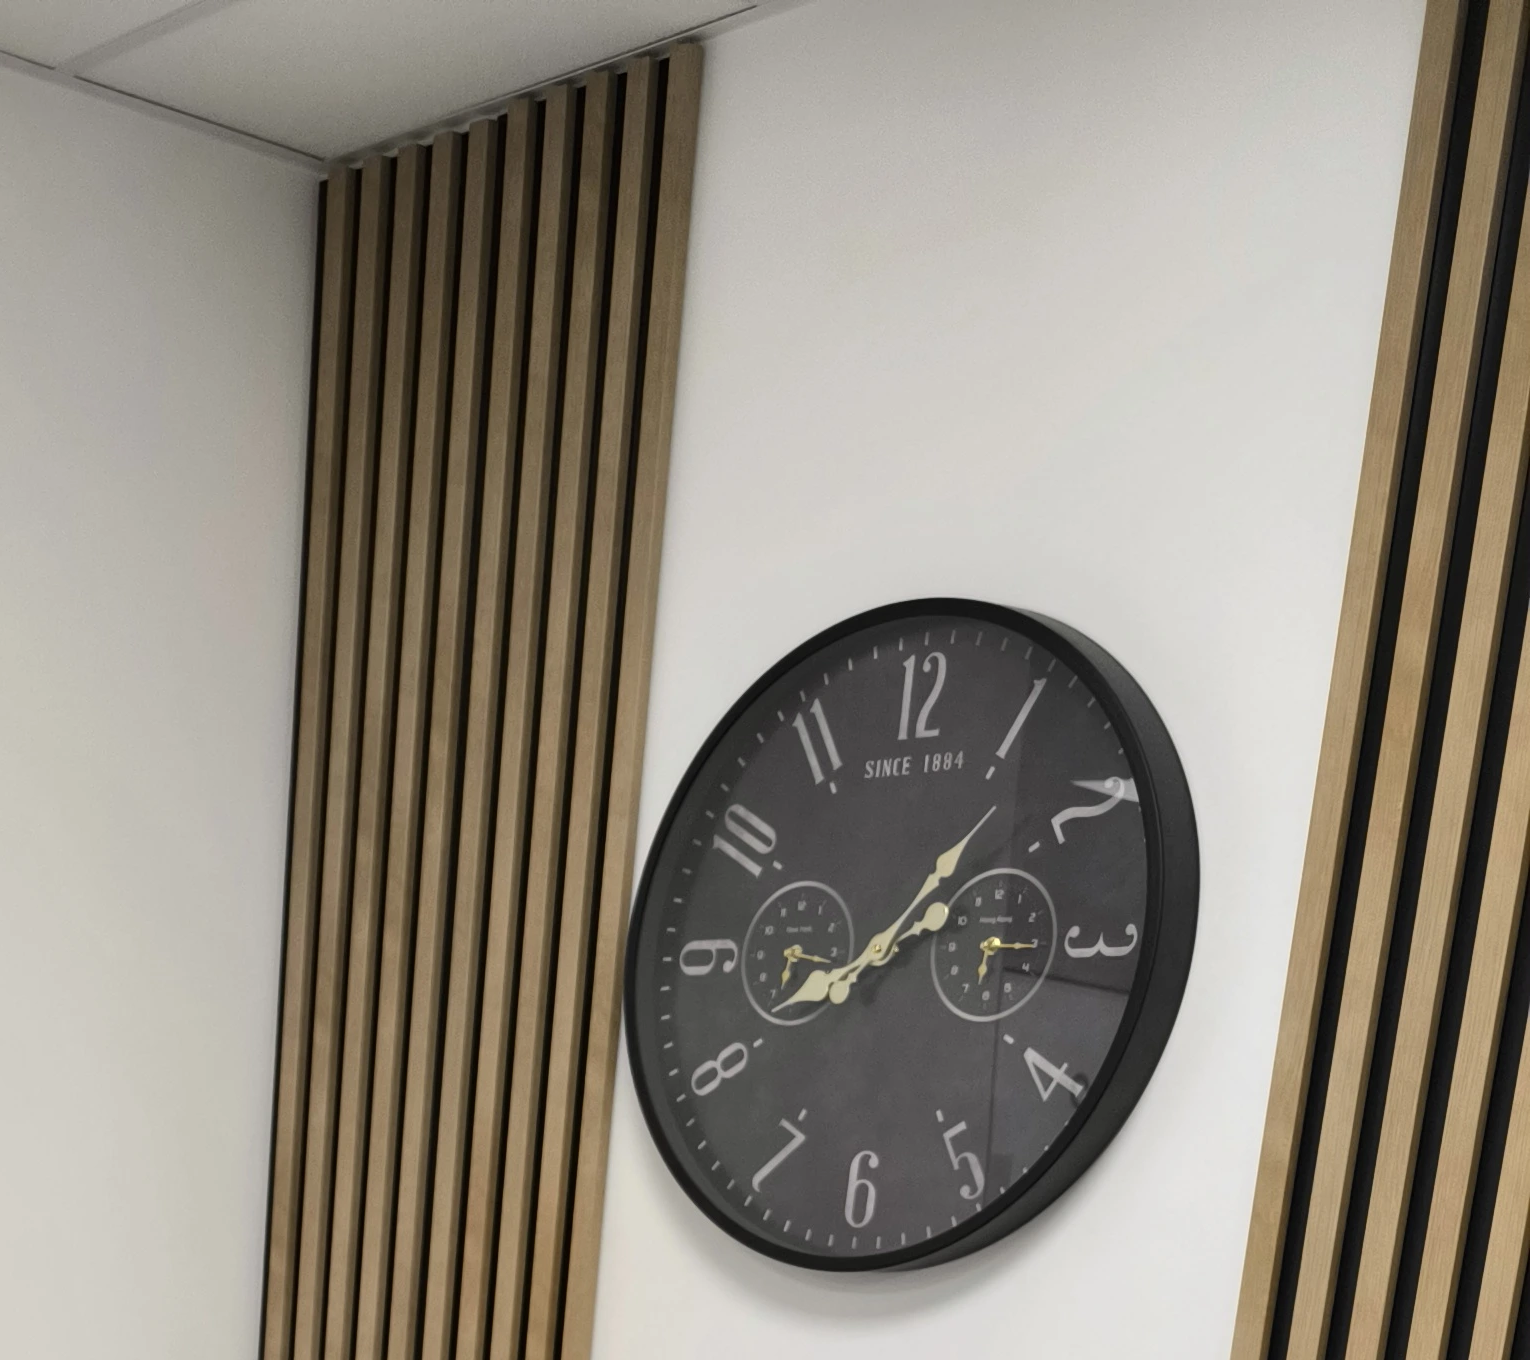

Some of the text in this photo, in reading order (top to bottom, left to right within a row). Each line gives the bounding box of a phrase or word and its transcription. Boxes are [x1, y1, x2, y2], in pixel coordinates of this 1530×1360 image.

[898, 651, 947, 741] 12
[996, 677, 1047, 759] 1
[792, 698, 843, 785] 11
[864, 750, 964, 779] SINCE 1884
[713, 803, 778, 879] 10
[1051, 776, 1126, 845] 2
[679, 938, 739, 978] 9
[1063, 924, 1138, 960] 3
[691, 1042, 748, 1097] 8
[1023, 1047, 1086, 1102] 4
[752, 1119, 806, 1193] 7
[844, 1150, 880, 1229] 6
[944, 1120, 985, 1200] 5
